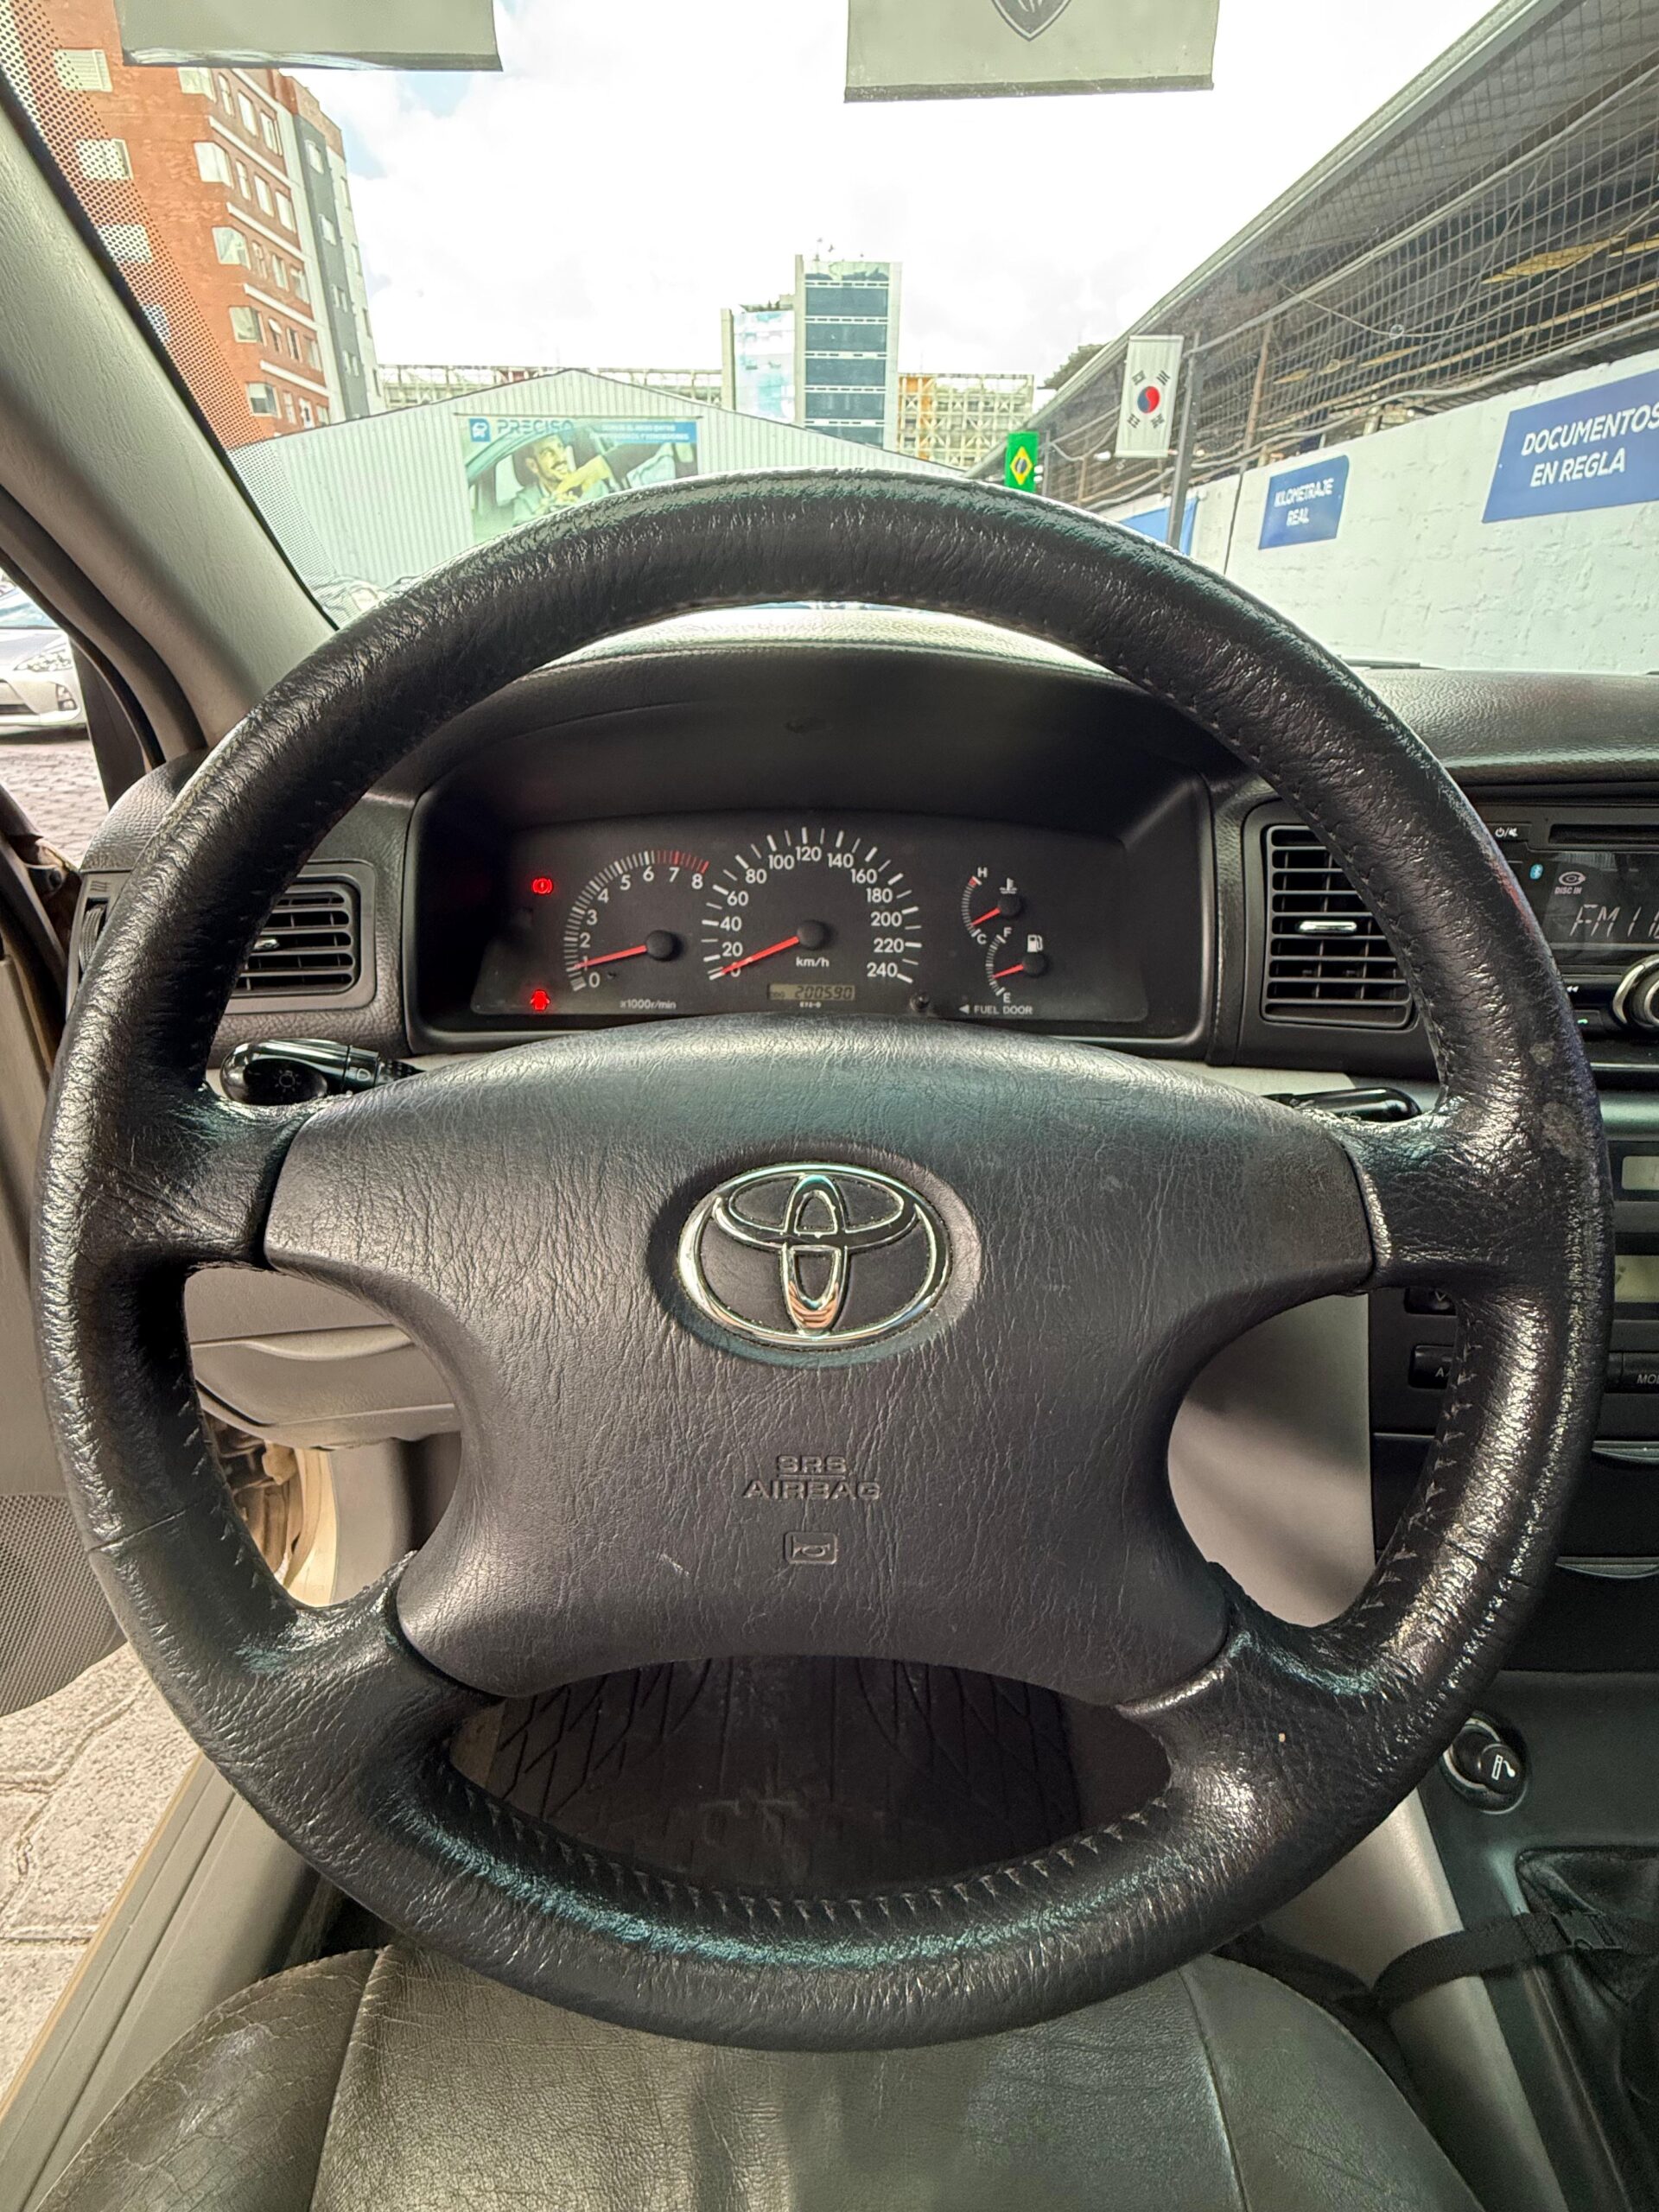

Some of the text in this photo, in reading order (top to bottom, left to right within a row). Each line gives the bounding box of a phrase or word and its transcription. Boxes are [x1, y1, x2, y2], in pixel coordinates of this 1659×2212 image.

[497, 419, 574, 435] PRECISO
[1521, 402, 1659, 456] DOCUMENTOS
[1530, 448, 1626, 487] EN REGLA
[1274, 478, 1334, 507] KILOMETRAJE
[1287, 507, 1309, 525] REAL
[795, 846, 822, 861] 120
[828, 853, 854, 868] 140
[769, 855, 795, 870] 100
[643, 866, 654, 881] 6
[669, 867, 680, 882] 7
[745, 868, 767, 884] 80
[851, 868, 878, 884] 160
[977, 867, 988, 878] H
[620, 874, 631, 890] 5
[691, 874, 703, 889] 8
[598, 889, 609, 903] 4
[727, 890, 749, 906] 60
[866, 887, 893, 903] 180
[587, 909, 597, 925] 3
[720, 916, 742, 931] 40
[870, 912, 902, 927] 200
[977, 934, 987, 944] C
[1003, 927, 1012, 938] F
[580, 933, 590, 948] 2
[873, 938, 905, 953] 220
[721, 942, 743, 957] 20
[796, 956, 830, 968] km/h
[867, 962, 898, 978] 240
[589, 972, 601, 988] 0
[795, 986, 853, 1000] 200590
[1003, 993, 1011, 1004] E
[974, 1005, 1033, 1014] FUEL DOOR
[777, 1454, 847, 1474] SRS
[742, 1479, 880, 1500] AIRBAG
